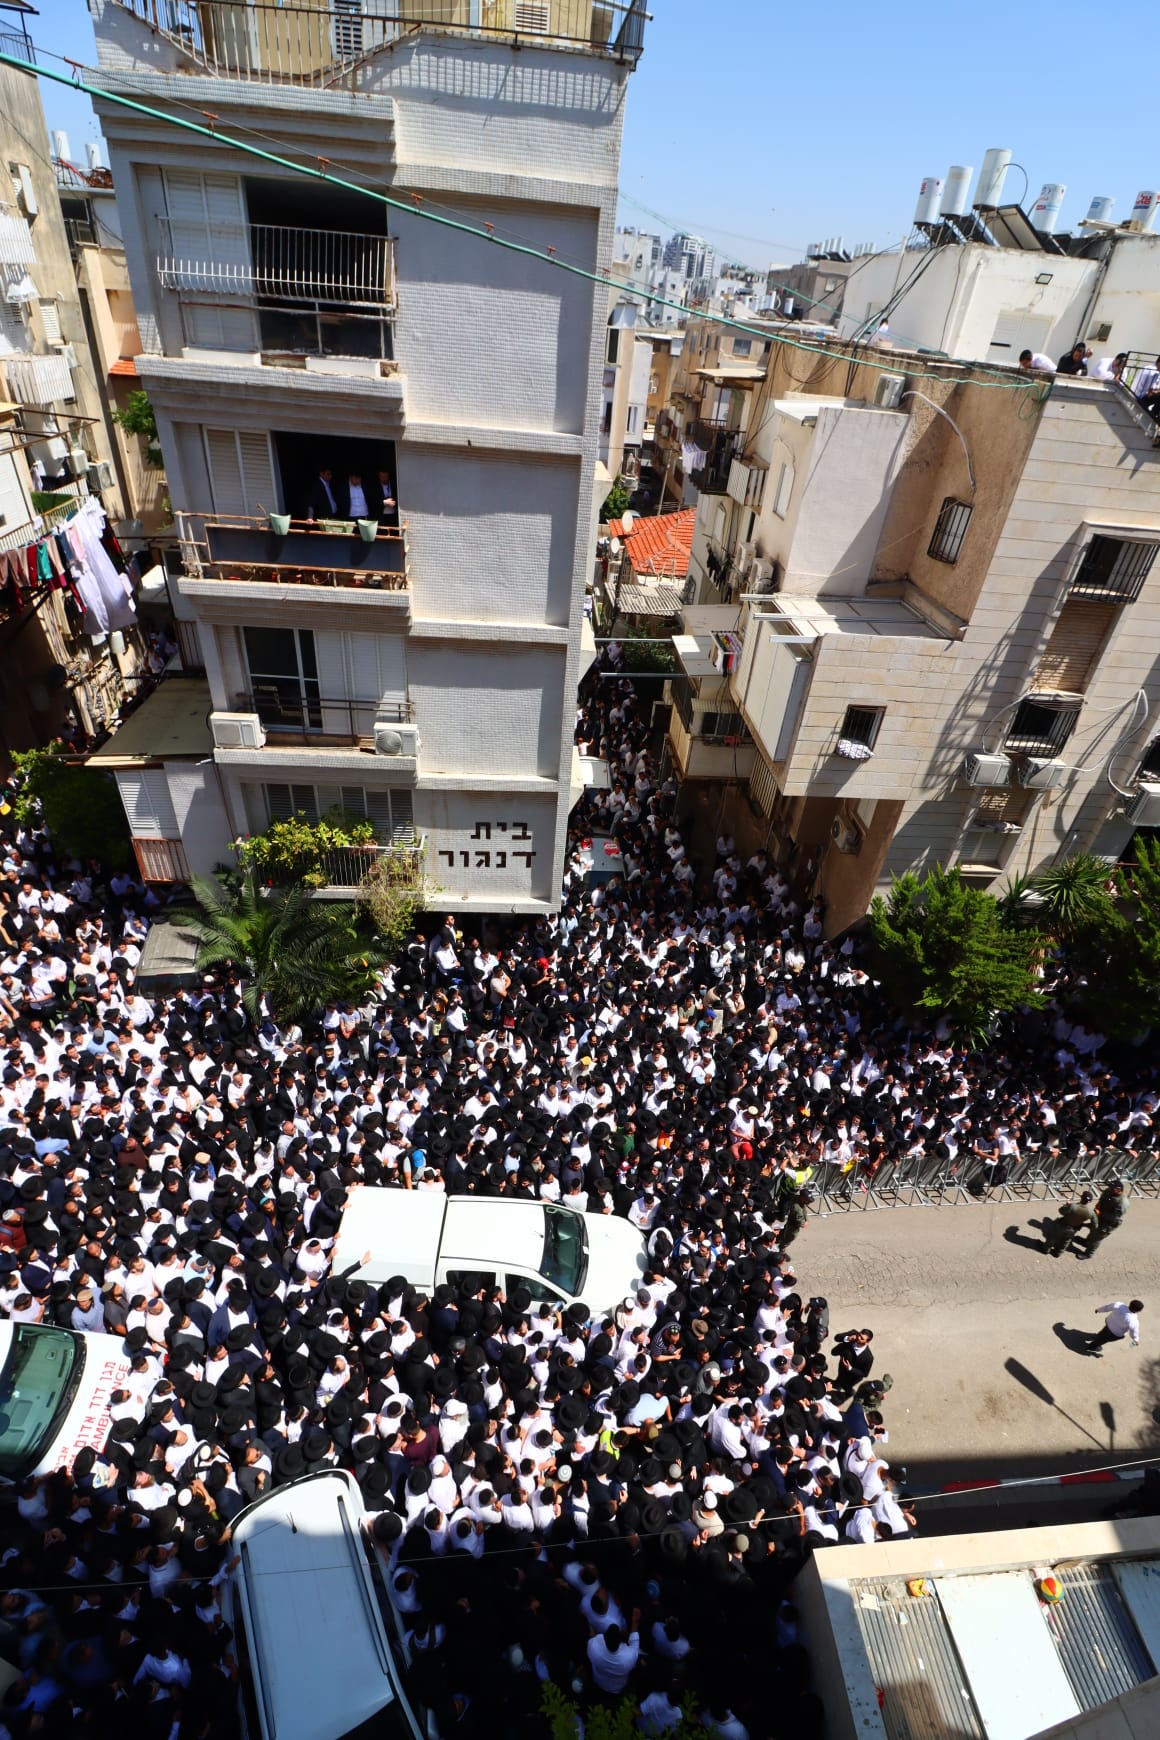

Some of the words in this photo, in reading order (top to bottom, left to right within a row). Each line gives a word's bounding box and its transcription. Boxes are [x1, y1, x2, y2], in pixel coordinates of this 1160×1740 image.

[470, 821, 531, 840] בית
[438, 850, 537, 868] דנגור
[99, 1361, 116, 1381] מגן
[88, 1387, 107, 1409] דוד
[90, 1363, 129, 1450] AMBUNCE
[73, 1415, 97, 1448] אדום
